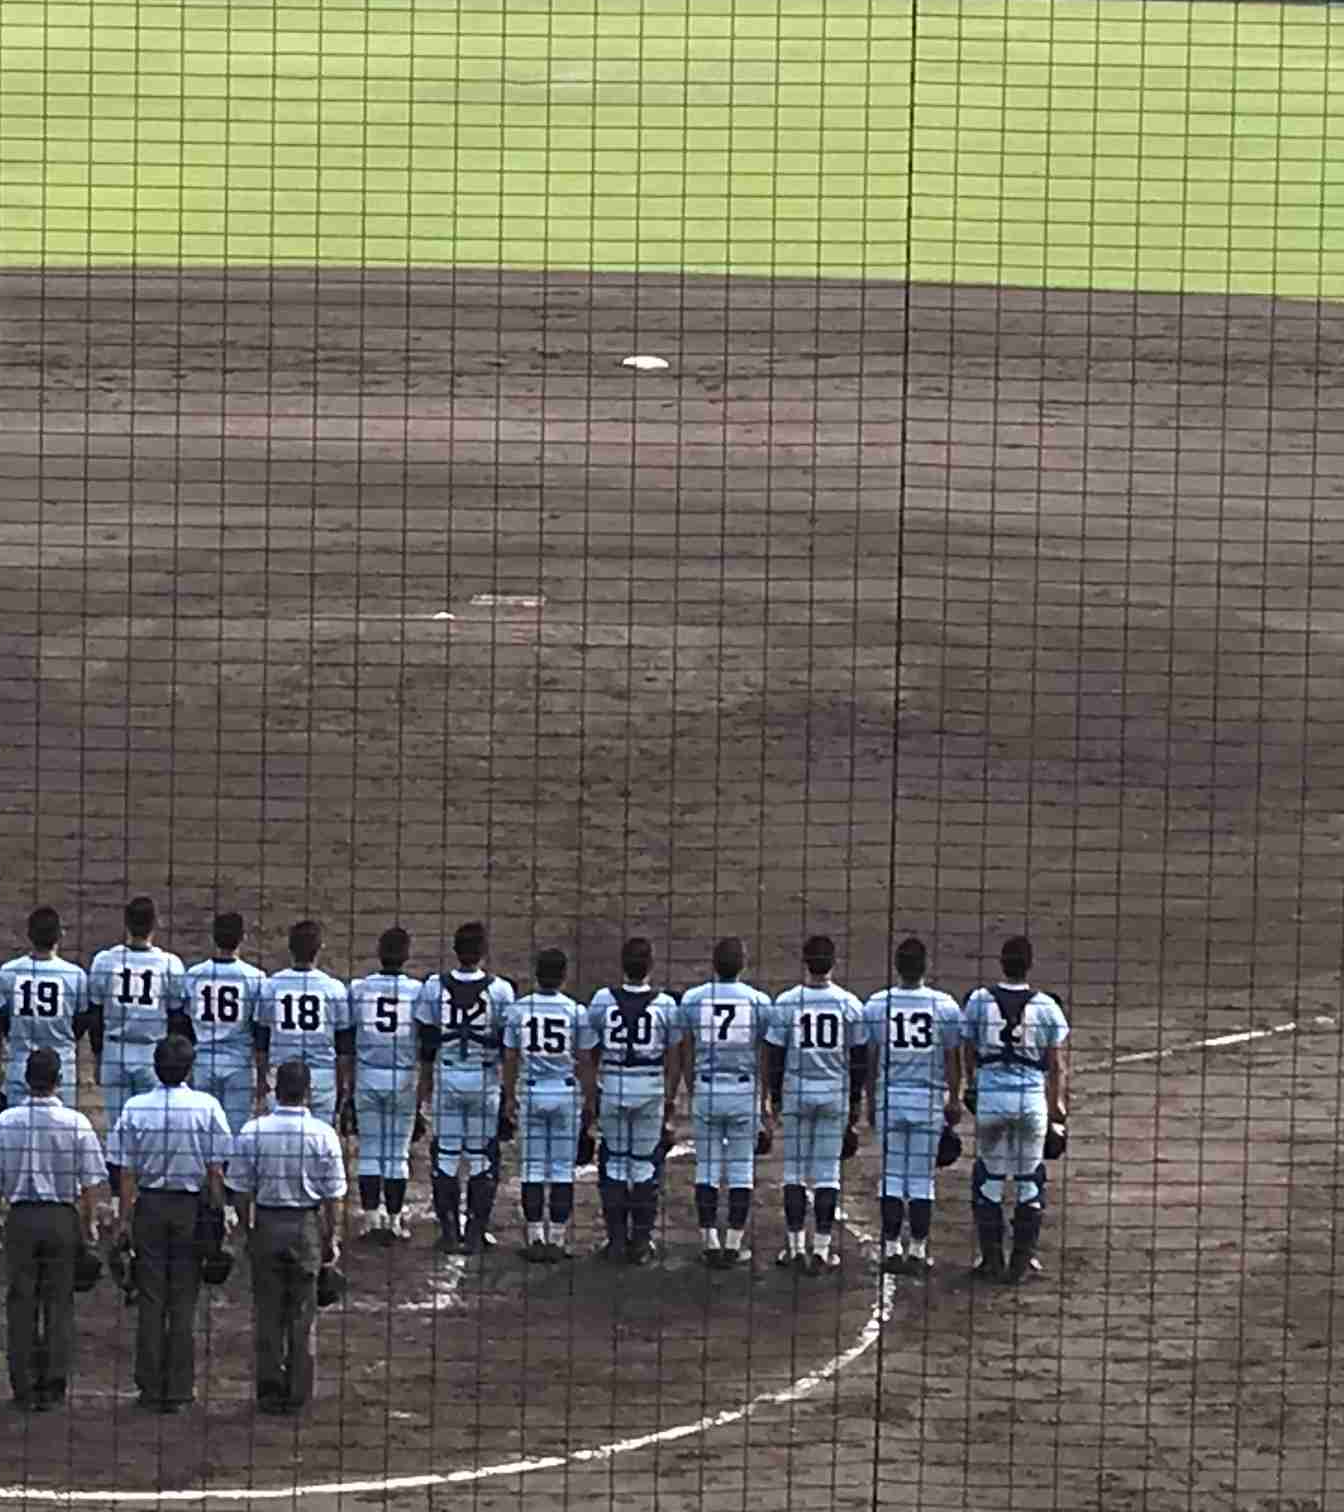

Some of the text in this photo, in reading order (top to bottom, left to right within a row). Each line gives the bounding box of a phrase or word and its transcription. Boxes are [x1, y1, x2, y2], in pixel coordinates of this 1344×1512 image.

[19, 981, 60, 1017] 19
[119, 969, 153, 1006] 11
[201, 985, 239, 1022] 16
[280, 994, 320, 1031] 18
[375, 997, 399, 1033] 5
[610, 1009, 653, 1047] 20
[712, 1005, 736, 1041] 7
[892, 1012, 933, 1048] 13
[525, 1016, 566, 1053] 15
[799, 1013, 839, 1049] 10
